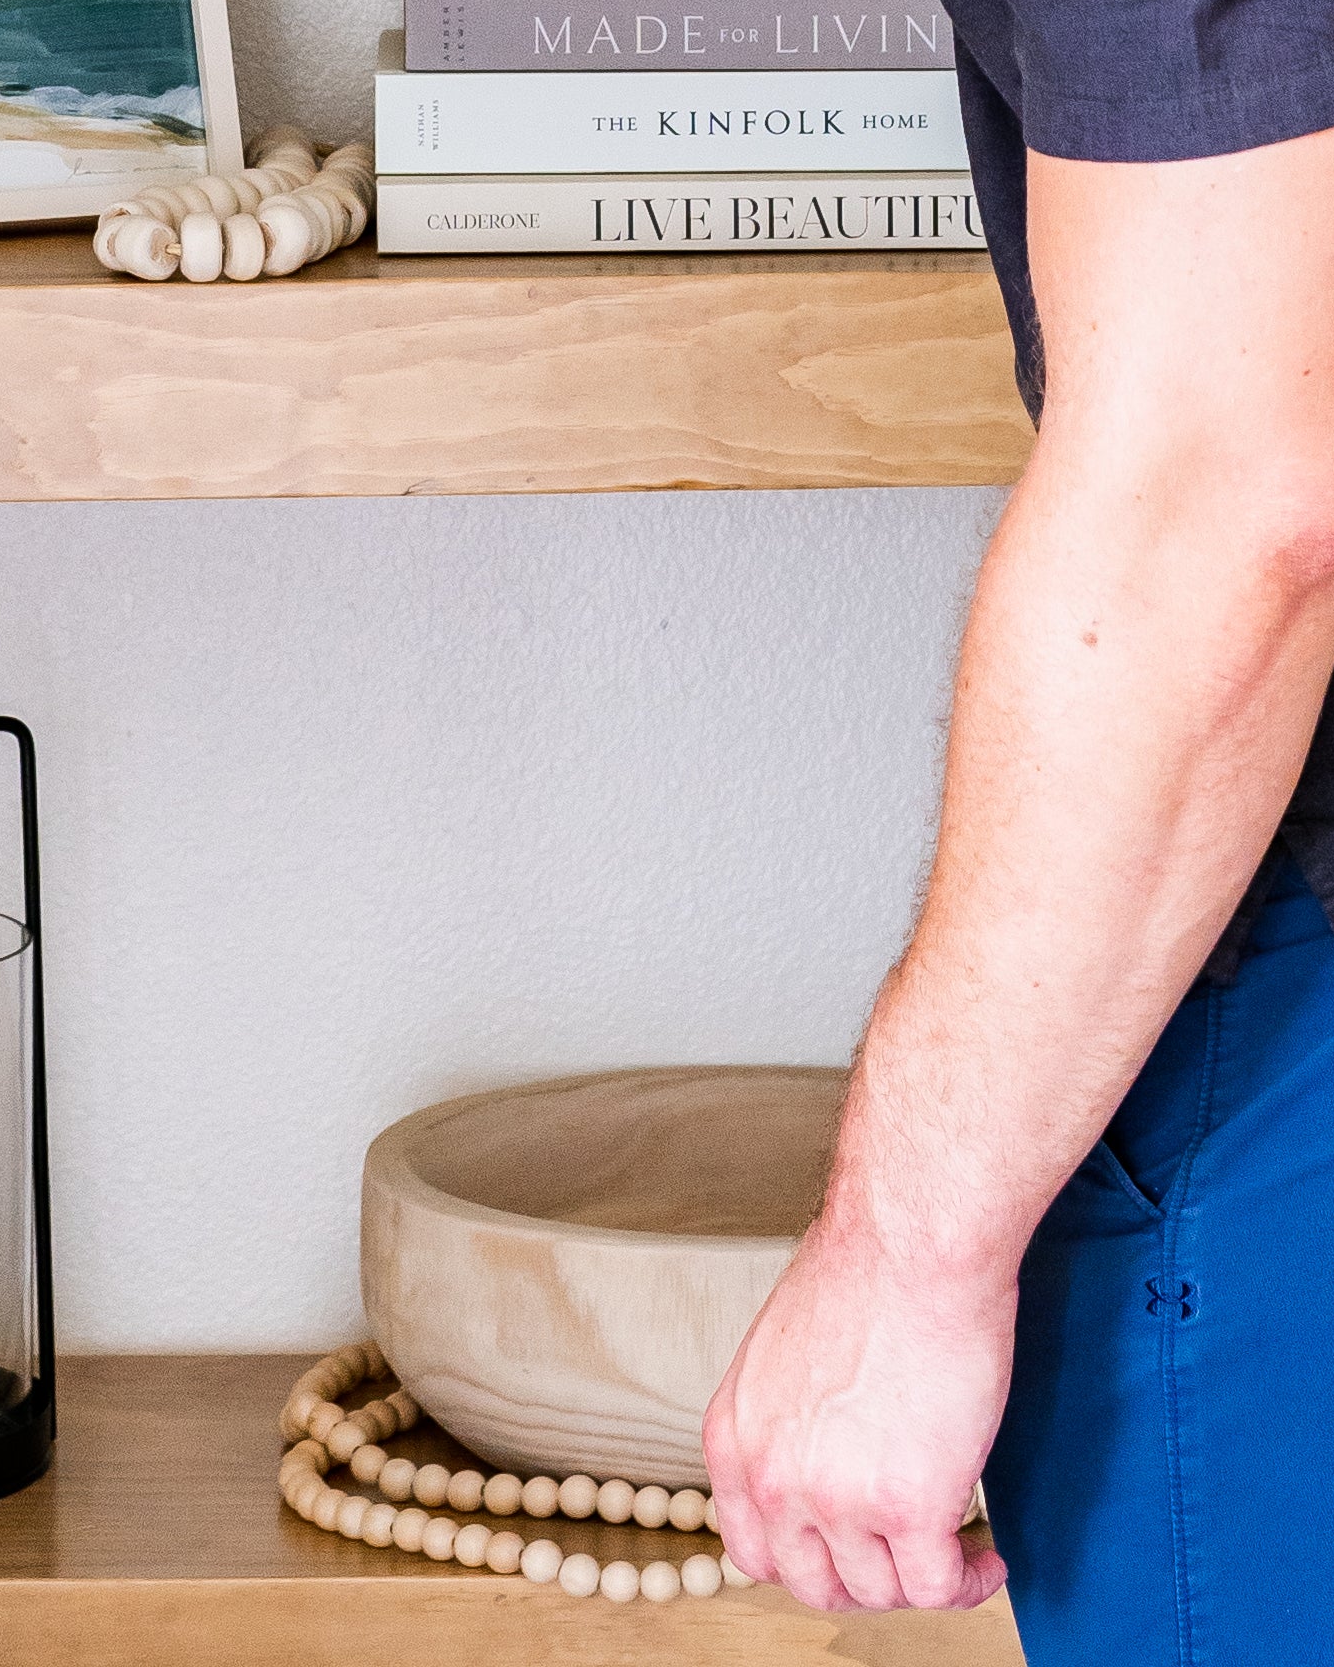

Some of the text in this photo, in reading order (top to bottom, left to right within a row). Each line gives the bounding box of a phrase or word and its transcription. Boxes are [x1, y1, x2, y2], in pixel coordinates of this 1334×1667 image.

[532, 14, 938, 55] MADE FOR LIVIN
[592, 109, 929, 136] THE KINFOLK HOME
[426, 213, 540, 230] CALDERONE
[591, 194, 984, 242] LIVE BEAUTIFU
